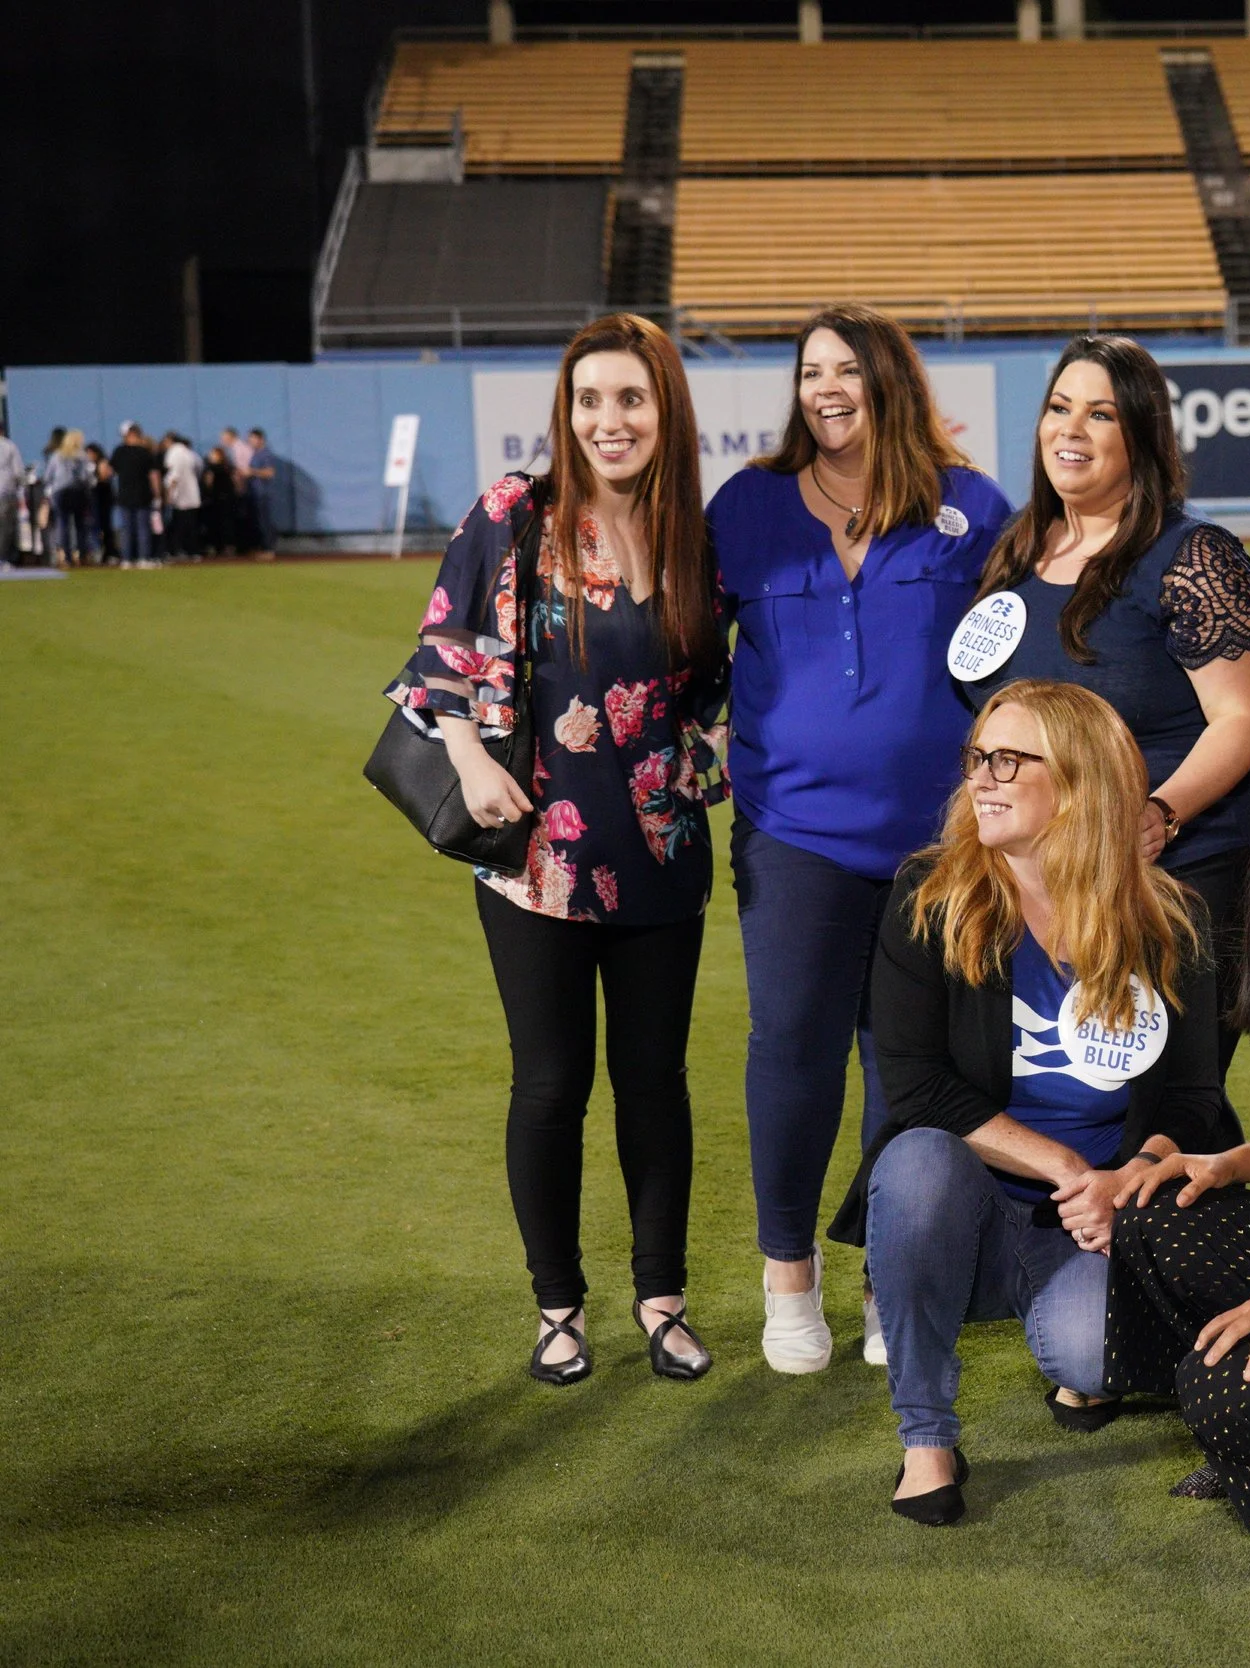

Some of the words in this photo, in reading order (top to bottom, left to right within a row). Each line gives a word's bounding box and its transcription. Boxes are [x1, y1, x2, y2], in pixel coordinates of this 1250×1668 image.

[966, 611, 1018, 641] PRINCESS
[959, 630, 1001, 657] BLEEDS
[953, 650, 984, 673] BLUE
[1077, 1021, 1147, 1051] BLEEDS
[1084, 1045, 1133, 1072] BLUE
